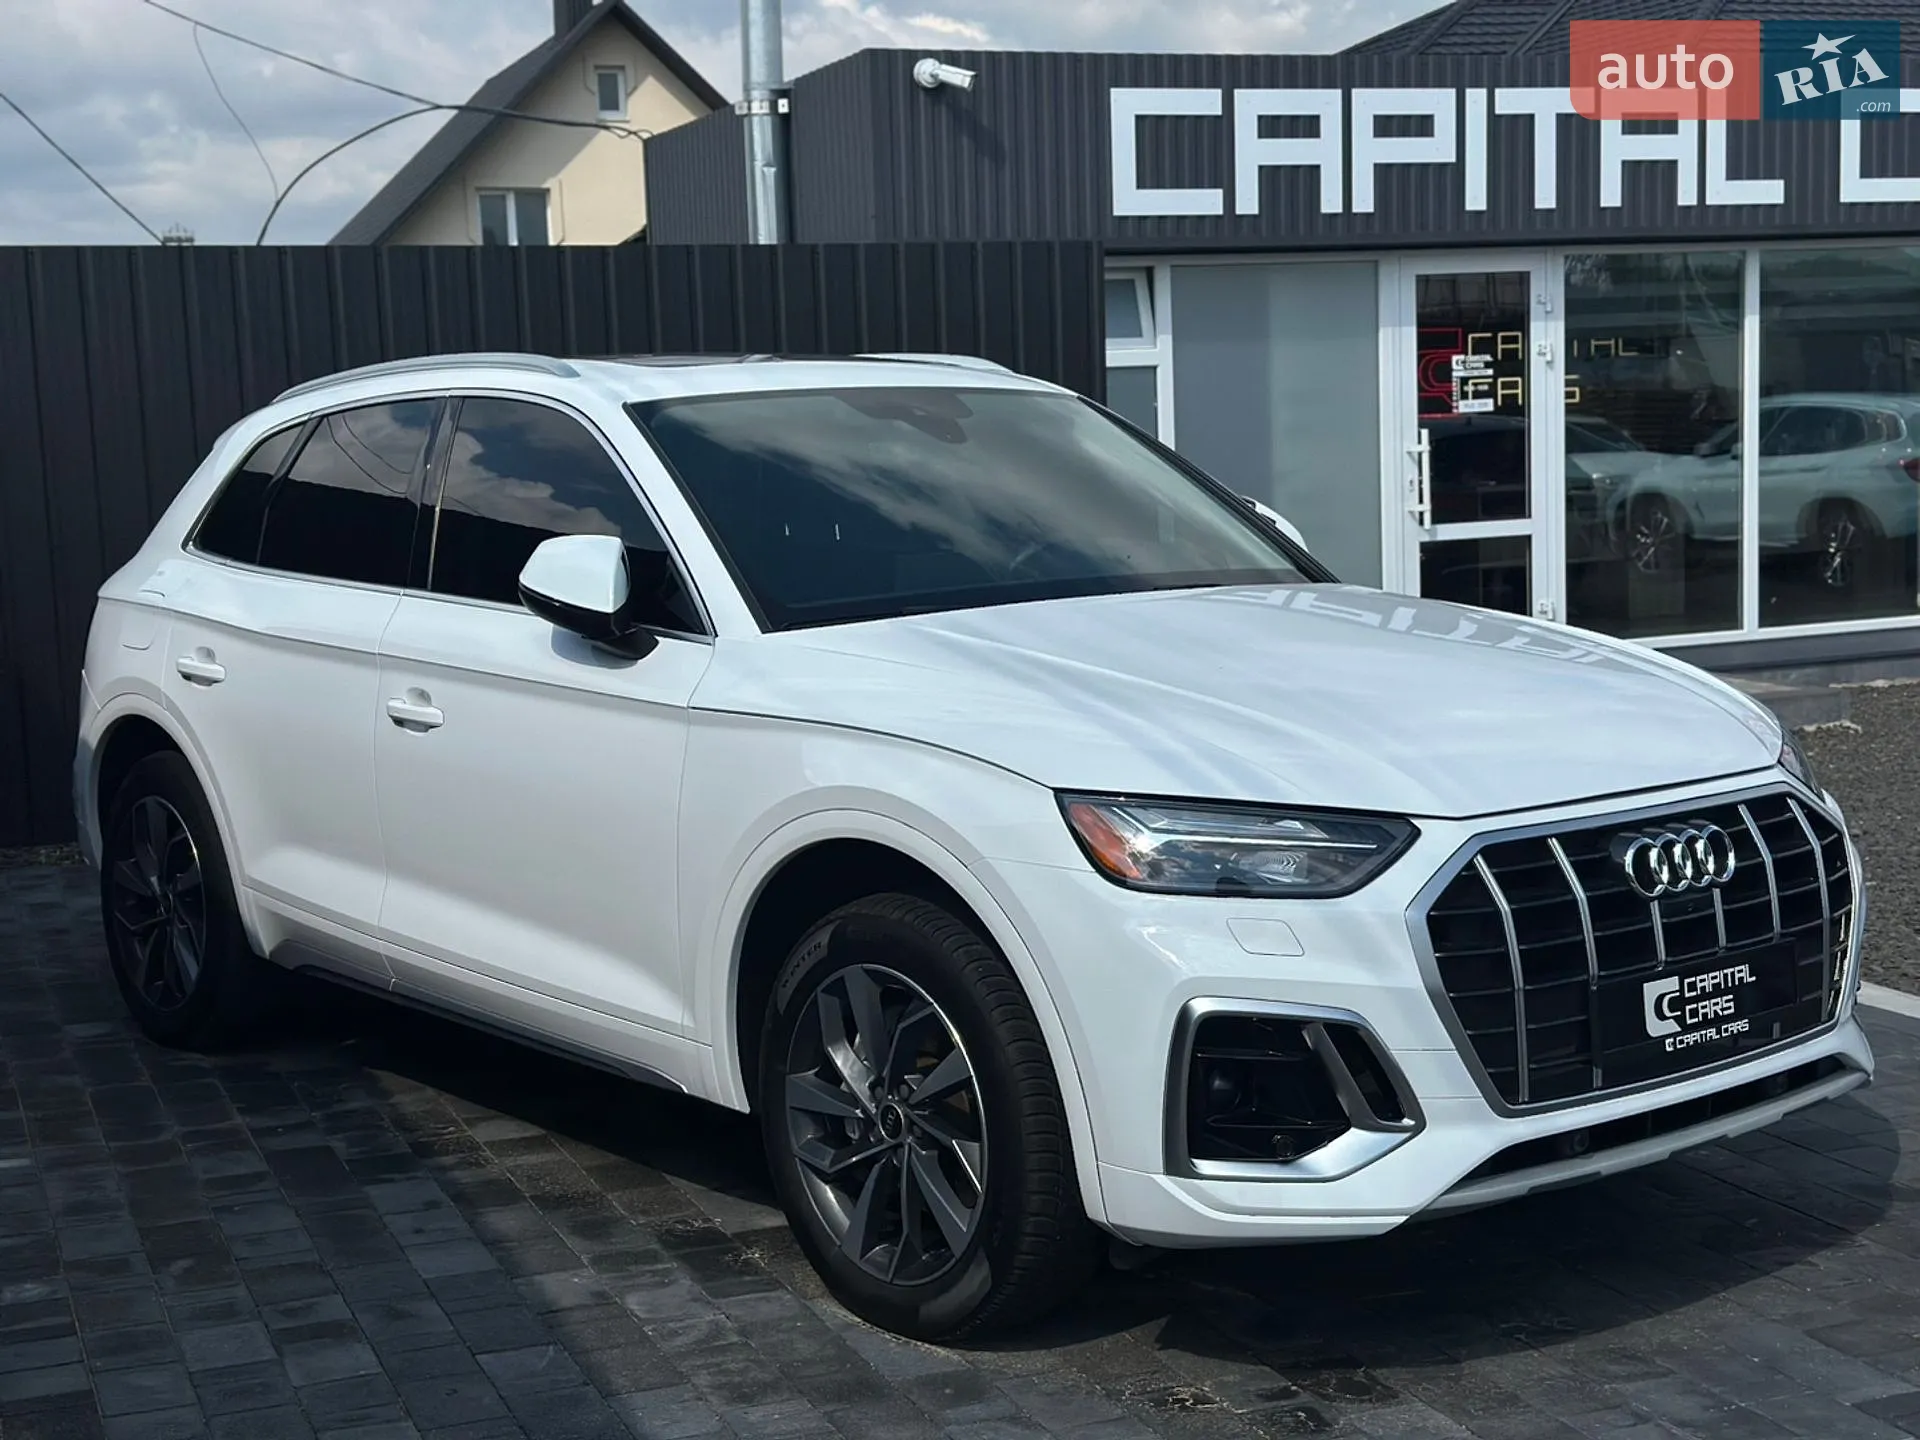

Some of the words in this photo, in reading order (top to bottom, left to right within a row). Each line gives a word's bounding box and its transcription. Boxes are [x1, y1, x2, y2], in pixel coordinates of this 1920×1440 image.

[1110, 88, 1784, 215] CAPITAL
[1684, 964, 1757, 997] CAPITAL
[1686, 995, 1735, 1024] CARS
[1676, 1028, 1720, 1049] CAPITAL
[1721, 1019, 1750, 1037] CARS
